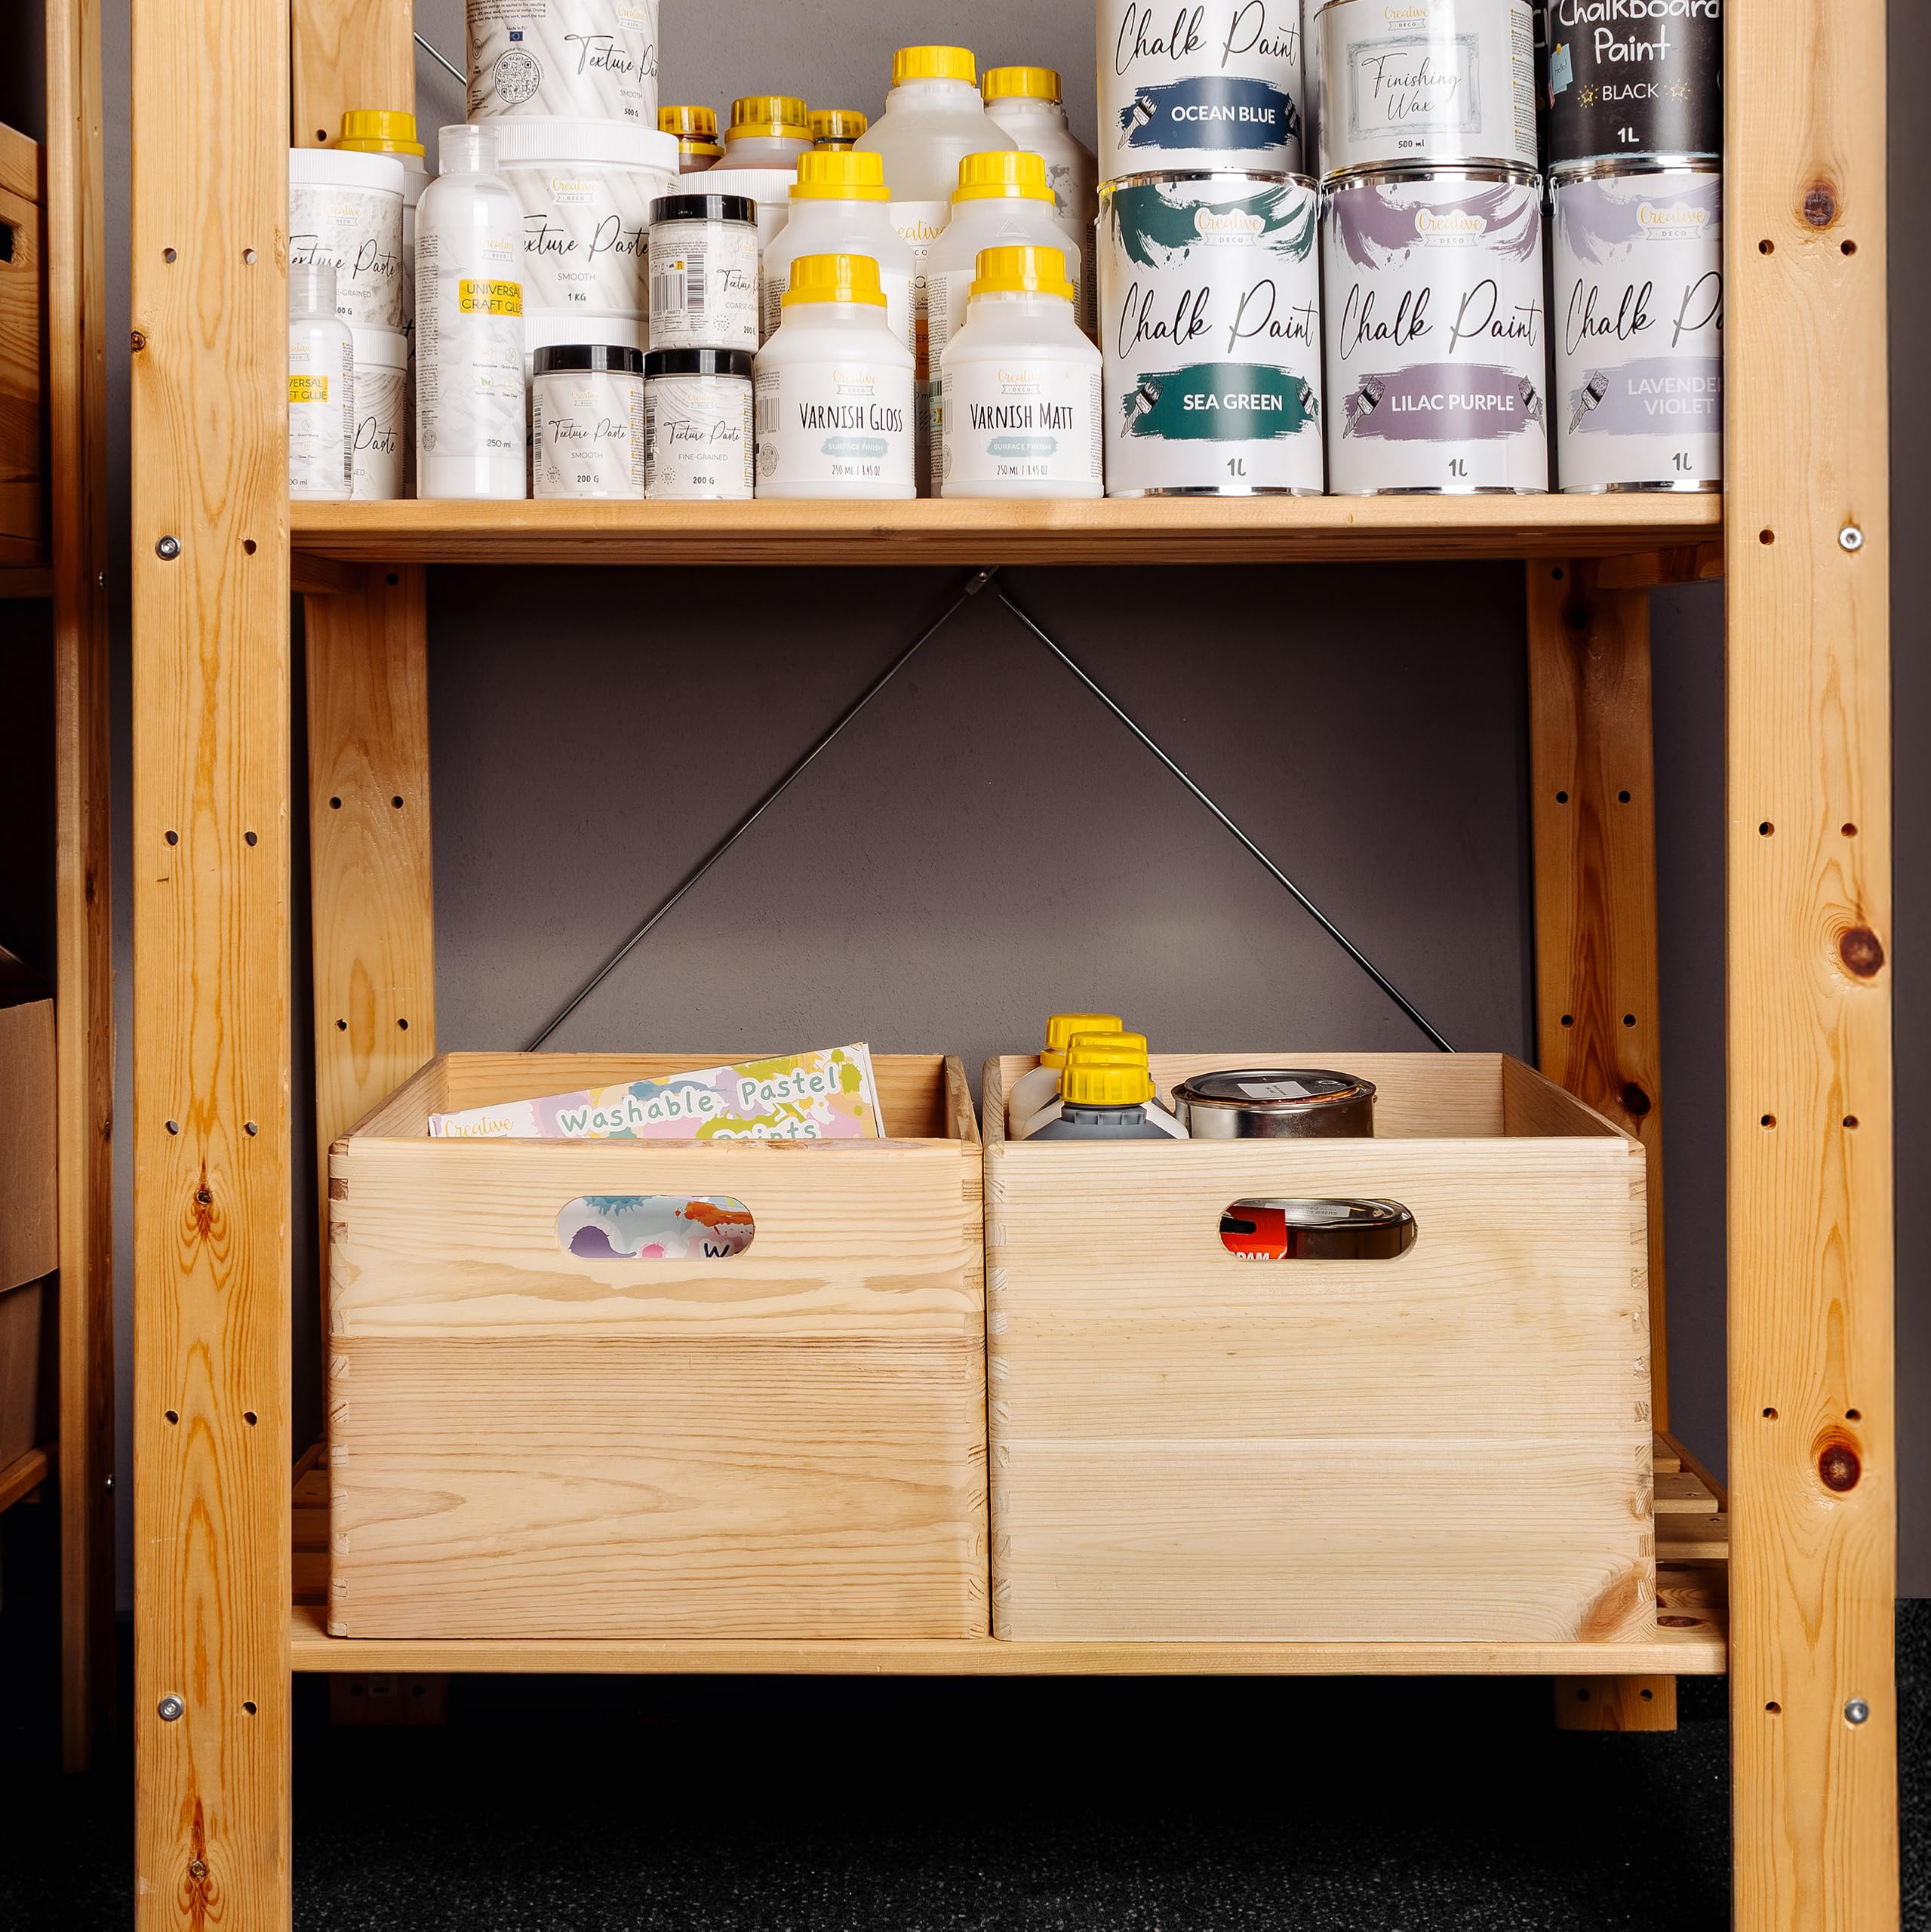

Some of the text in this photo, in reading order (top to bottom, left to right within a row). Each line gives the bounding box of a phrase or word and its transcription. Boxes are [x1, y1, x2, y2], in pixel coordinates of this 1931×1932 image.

[1384, 5, 1431, 20] Creative
[1115, 0, 1299, 76] Chalk Paint
[1594, 23, 1671, 64] Paint
[564, 34, 634, 75] Texture
[1361, 52, 1462, 102] Finishing
[620, 89, 644, 100] SMOOTH
[1602, 82, 1659, 102] BLACK
[624, 108, 639, 118] 500 G
[1170, 105, 1276, 125] OCEAN BLUE
[1387, 90, 1438, 122] Wax
[1398, 140, 1413, 149] 500
[1617, 128, 1640, 143] 1L
[552, 178, 596, 193] Creative
[1198, 209, 1262, 231] Creative
[1418, 210, 1484, 232] Creative
[1640, 205, 1708, 225] Creative
[588, 214, 650, 263] Paste
[898, 220, 948, 242] eative
[352, 238, 398, 280] Paste
[557, 272, 597, 282] SMOOTH
[716, 268, 752, 292] Texture
[466, 283, 521, 299] UNIVERSAL
[567, 293, 586, 303] 1 KG
[337, 306, 352, 315] 00 G
[461, 298, 503, 312] CRAFT
[1118, 281, 1213, 360] Chalk
[1228, 278, 1319, 355] Paint
[1340, 278, 1543, 361] Chalk Paint
[1565, 278, 1656, 356] Chalk
[743, 325, 752, 334] 200
[832, 368, 879, 386] Creative
[301, 390, 327, 400] GLUE
[1182, 394, 1284, 411] SEA GREEN
[1391, 394, 1514, 412] LILAC PURPLE
[970, 402, 1074, 430] VARNISH MATT
[1644, 397, 1715, 416] VIOLET
[799, 402, 903, 433] VARNISH GLOSS
[353, 416, 398, 454] Paste
[549, 417, 628, 444] Texture Paste
[663, 420, 742, 445] Texture Paste
[487, 439, 503, 448] 250
[862, 441, 884, 452] FINISH
[993, 442, 1025, 451] SURFACE
[678, 453, 729, 461] FINE-GRAINED
[832, 464, 844, 475] 250
[844, 466, 853, 475] ML
[997, 464, 1008, 475] 250
[1009, 466, 1019, 475] ML
[577, 475, 599, 484] 200 G
[693, 476, 707, 485] 200
[560, 1066, 837, 1134] Washable Pastel
[444, 1115, 514, 1137] Creative
